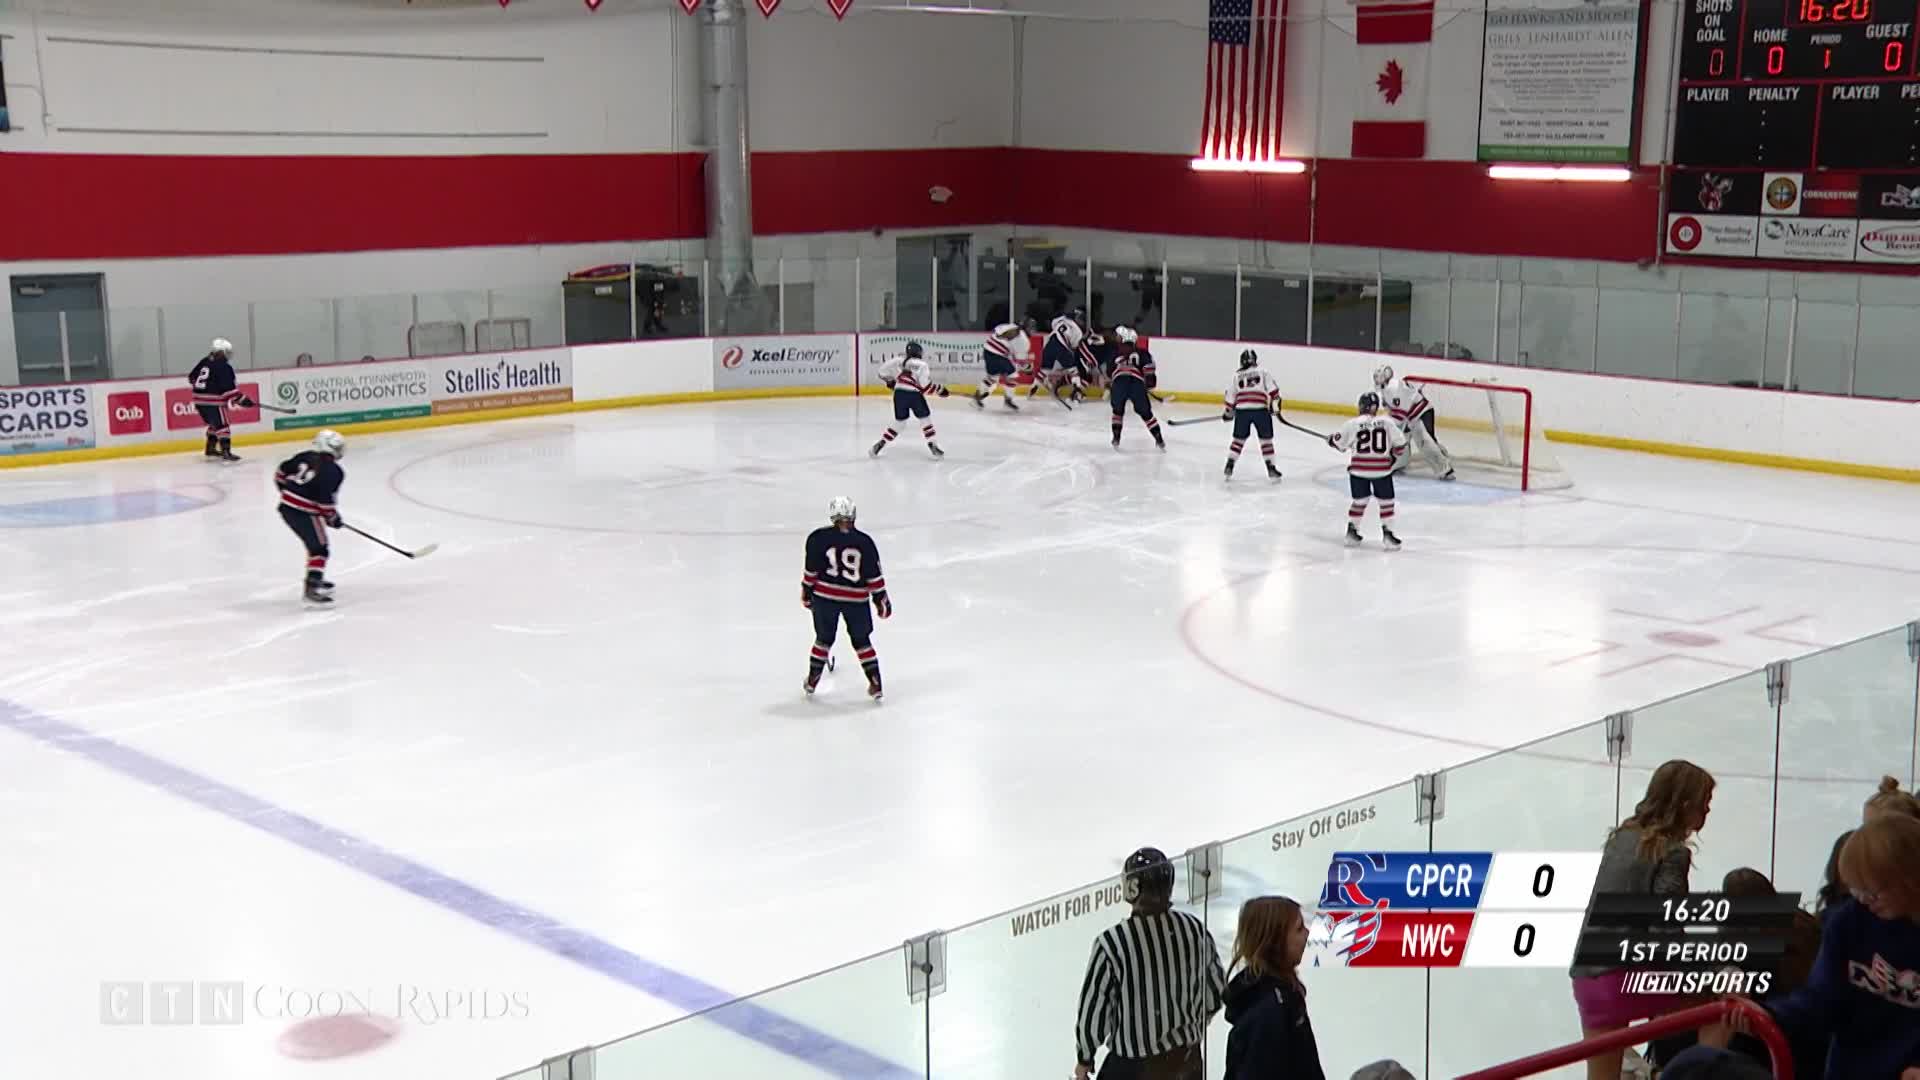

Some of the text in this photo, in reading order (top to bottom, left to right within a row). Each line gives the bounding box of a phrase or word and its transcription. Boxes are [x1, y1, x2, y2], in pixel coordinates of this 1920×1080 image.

[1696, 0, 1733, 13] SHOTS
[1705, 14, 1720, 27] ON
[1866, 23, 1911, 39] GUEST
[1697, 29, 1727, 42] GOAL
[1754, 29, 1789, 42] HOME
[1811, 34, 1843, 45] PERIOD
[1709, 49, 1724, 75] 0
[1767, 46, 1784, 75] 0
[1884, 42, 1903, 72] 0
[1687, 87, 1801, 101] PLAYER PENALTY
[1832, 85, 1881, 100] PLAYER
[1786, 223, 1851, 240] NovaCare
[195, 366, 210, 390] 2
[444, 360, 561, 394] Stellis Health
[0, 387, 86, 410] SPORTS
[305, 382, 427, 404] ORTHODONTICS
[0, 409, 89, 434] CARDS
[115, 405, 144, 420] Cub
[1356, 429, 1387, 454] 20
[825, 546, 862, 583] 19
[1272, 805, 1377, 852] Stay Off Glass
[1011, 903, 1060, 937] WATCH
[1065, 894, 1091, 920] FOR
